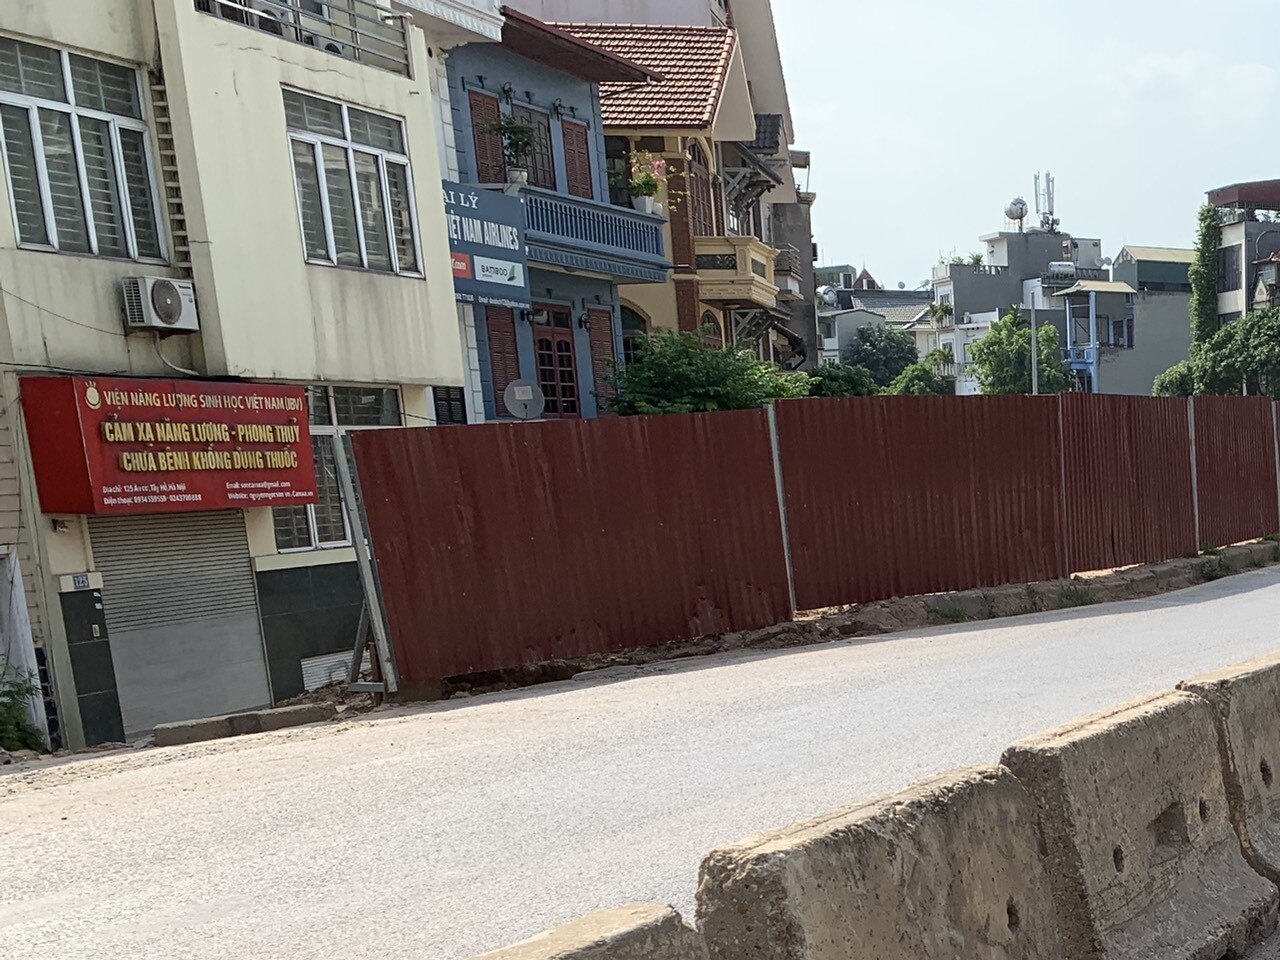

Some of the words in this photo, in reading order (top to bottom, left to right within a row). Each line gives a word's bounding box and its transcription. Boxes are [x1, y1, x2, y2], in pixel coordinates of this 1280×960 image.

[458, 192, 479, 209] LÝ
[461, 216, 483, 244] NAM
[483, 220, 519, 250] AIRLINES
[103, 388, 129, 410] VIỆN
[199, 393, 222, 408] SINH
[223, 395, 245, 413] HỌC
[245, 393, 265, 413] VIỆT
[237, 424, 274, 443] PHONG
[192, 447, 232, 471] KHÔNG
[233, 446, 264, 470] DÙNG
[264, 444, 298, 469] THUỐC
